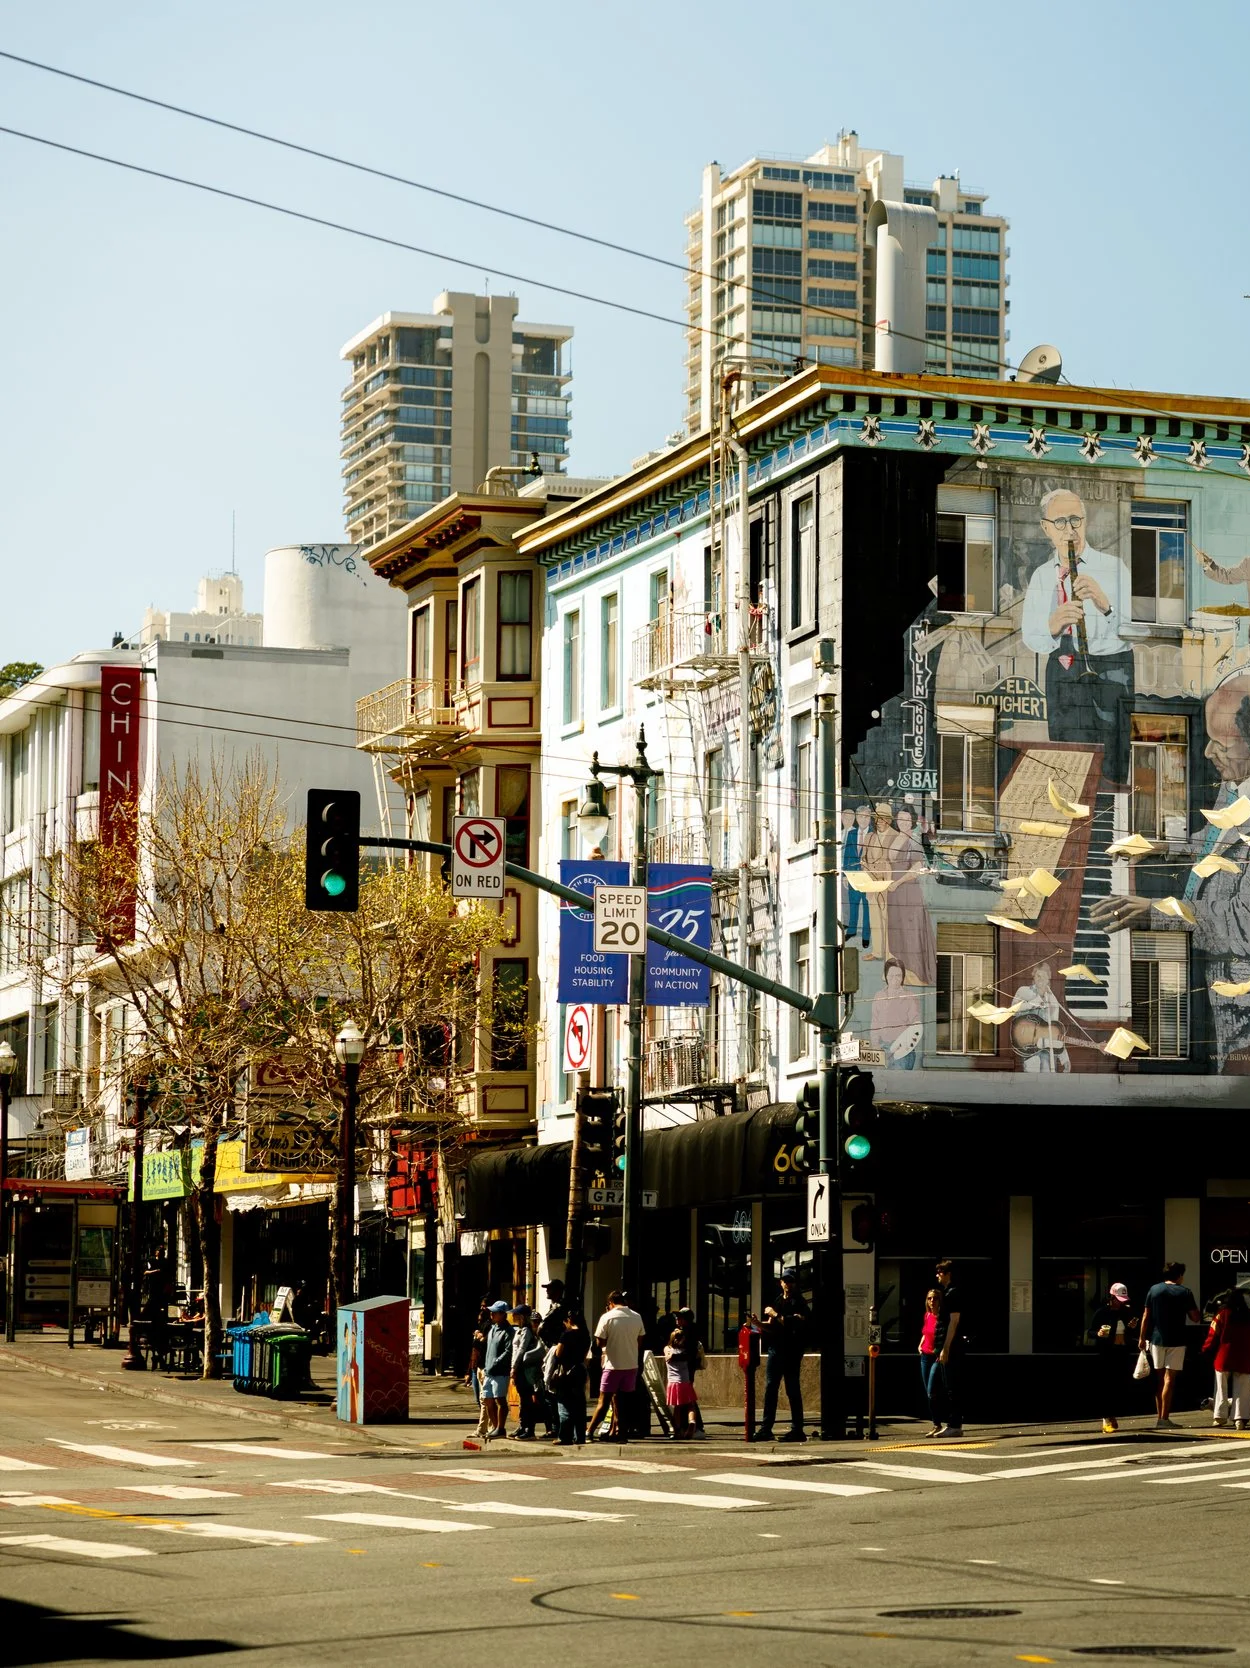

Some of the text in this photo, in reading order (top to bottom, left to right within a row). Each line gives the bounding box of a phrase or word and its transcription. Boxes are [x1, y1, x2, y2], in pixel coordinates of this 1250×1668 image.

[914, 630, 925, 695] MULIN
[914, 705, 924, 758] ROUGE
[455, 875, 501, 888] ON RED
[599, 893, 642, 905] SPEED
[603, 908, 637, 918] LIMIT
[658, 909, 705, 942] 25
[600, 921, 640, 946] 20
[580, 954, 605, 963] FOOD
[574, 966, 613, 975] HOUSING
[649, 967, 702, 977] COMMUNITY
[572, 979, 615, 988] STABILITY
[654, 981, 698, 990] IN ACTION
[810, 1223, 827, 1238] ONLY
[1210, 1249, 1248, 1264] OPEN
